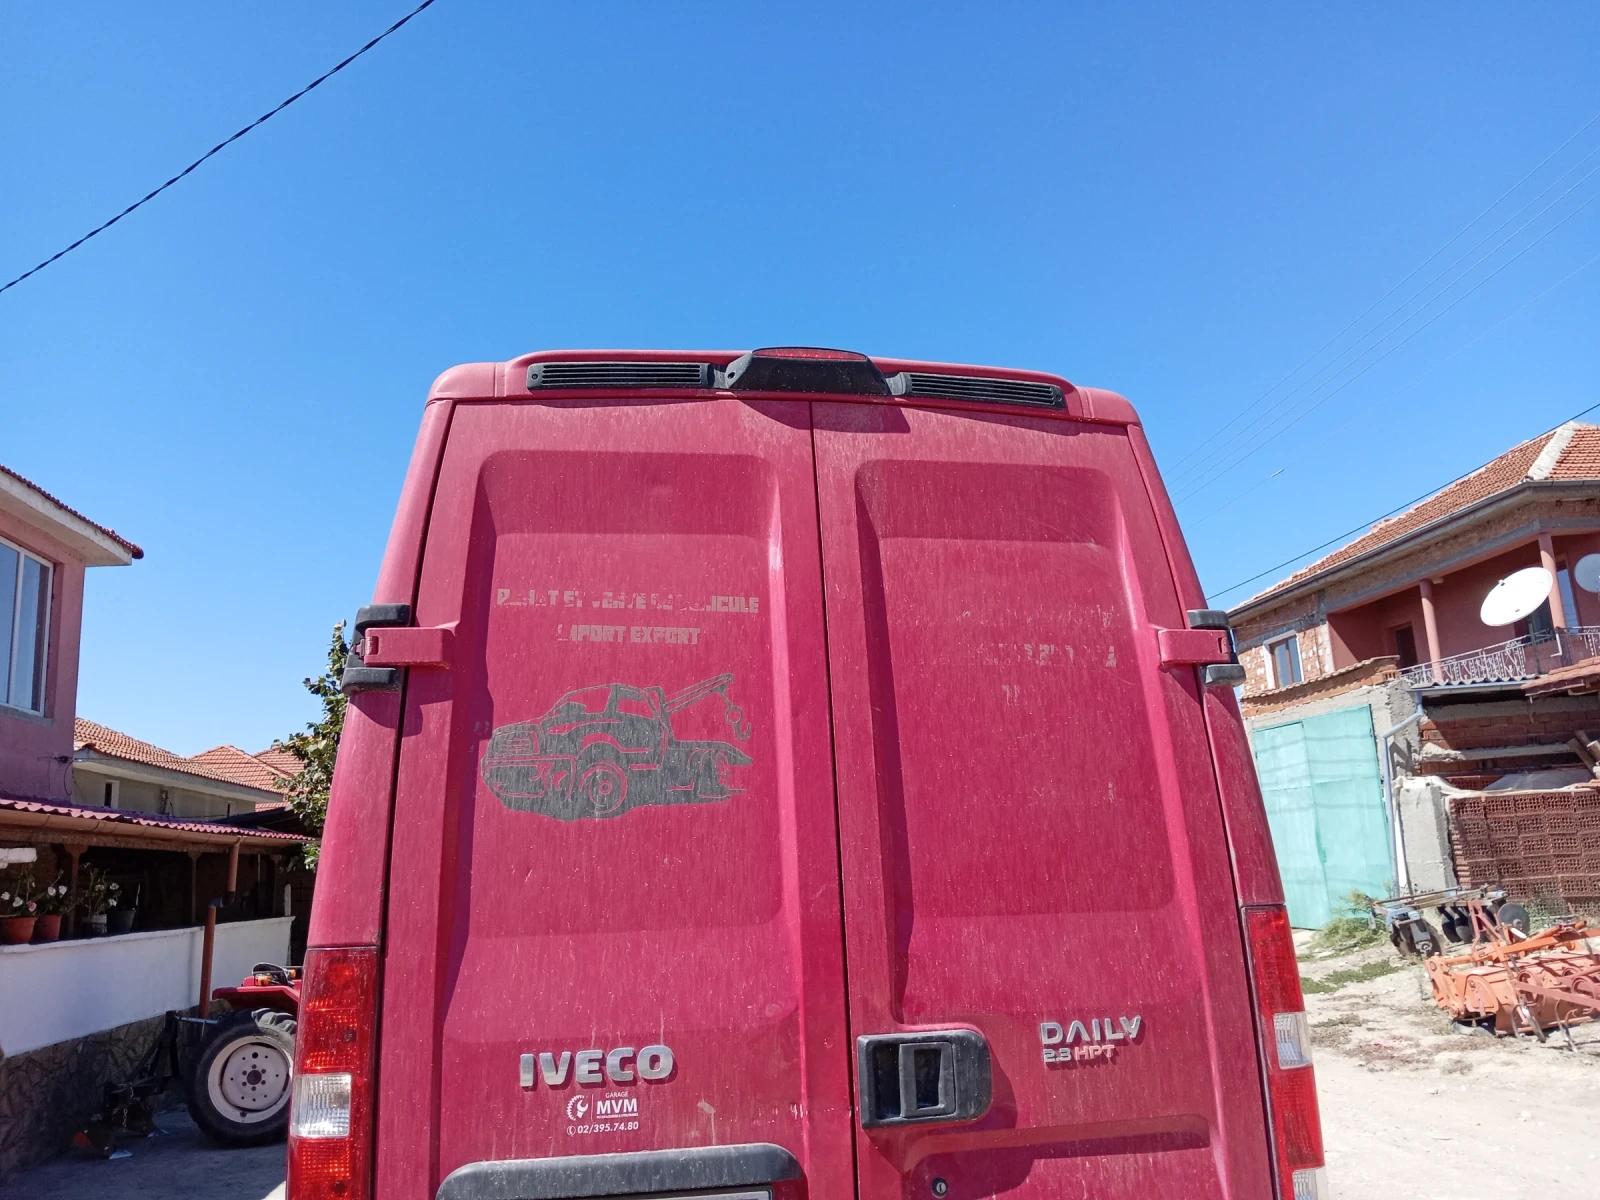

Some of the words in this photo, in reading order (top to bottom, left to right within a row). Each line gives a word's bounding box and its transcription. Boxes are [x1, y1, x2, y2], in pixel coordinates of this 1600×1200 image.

[631, 626, 701, 644] EXPORT
[1040, 1015, 1141, 1045] DAILY
[519, 1045, 675, 1087] IVECO
[596, 1098, 638, 1115] MVM
[577, 1121, 639, 1134] 02/395.74.80
